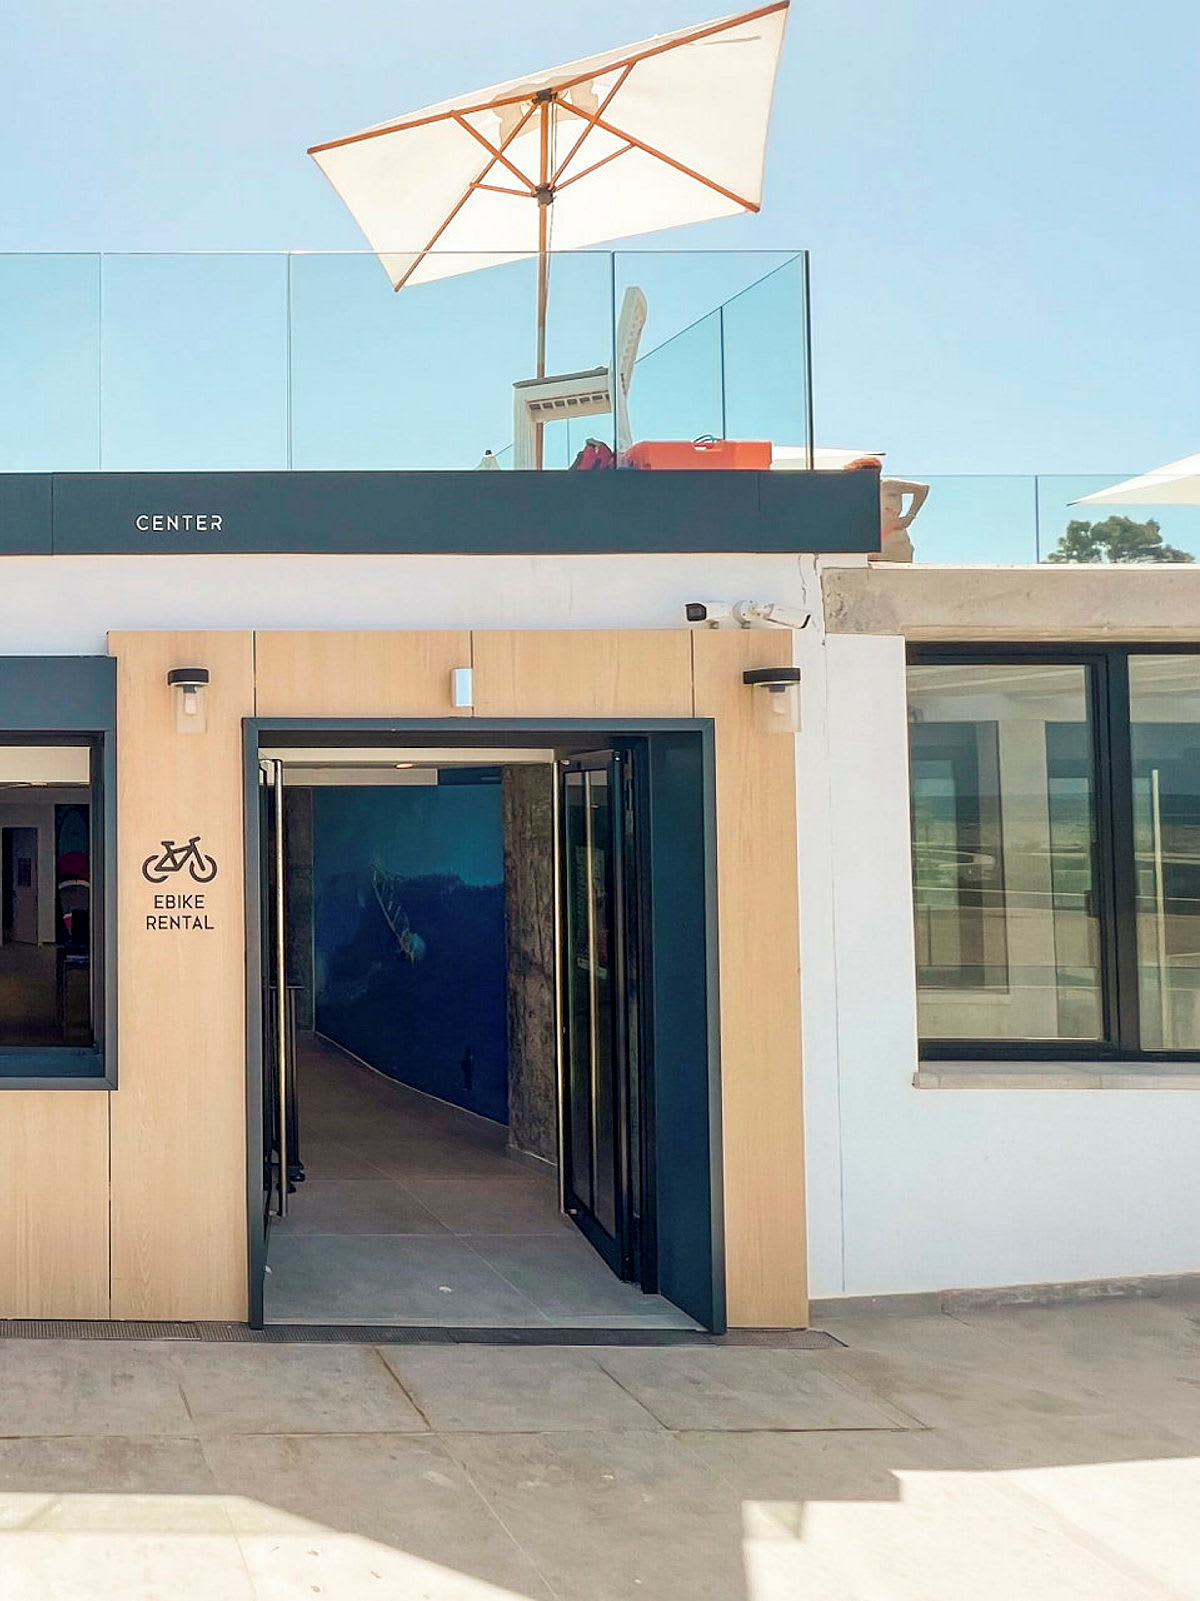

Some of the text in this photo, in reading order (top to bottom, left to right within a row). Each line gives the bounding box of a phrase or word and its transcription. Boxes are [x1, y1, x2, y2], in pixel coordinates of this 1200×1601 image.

[136, 514, 223, 531] CENTER
[154, 894, 205, 909] EBIKE
[146, 915, 215, 930] RENTAL
